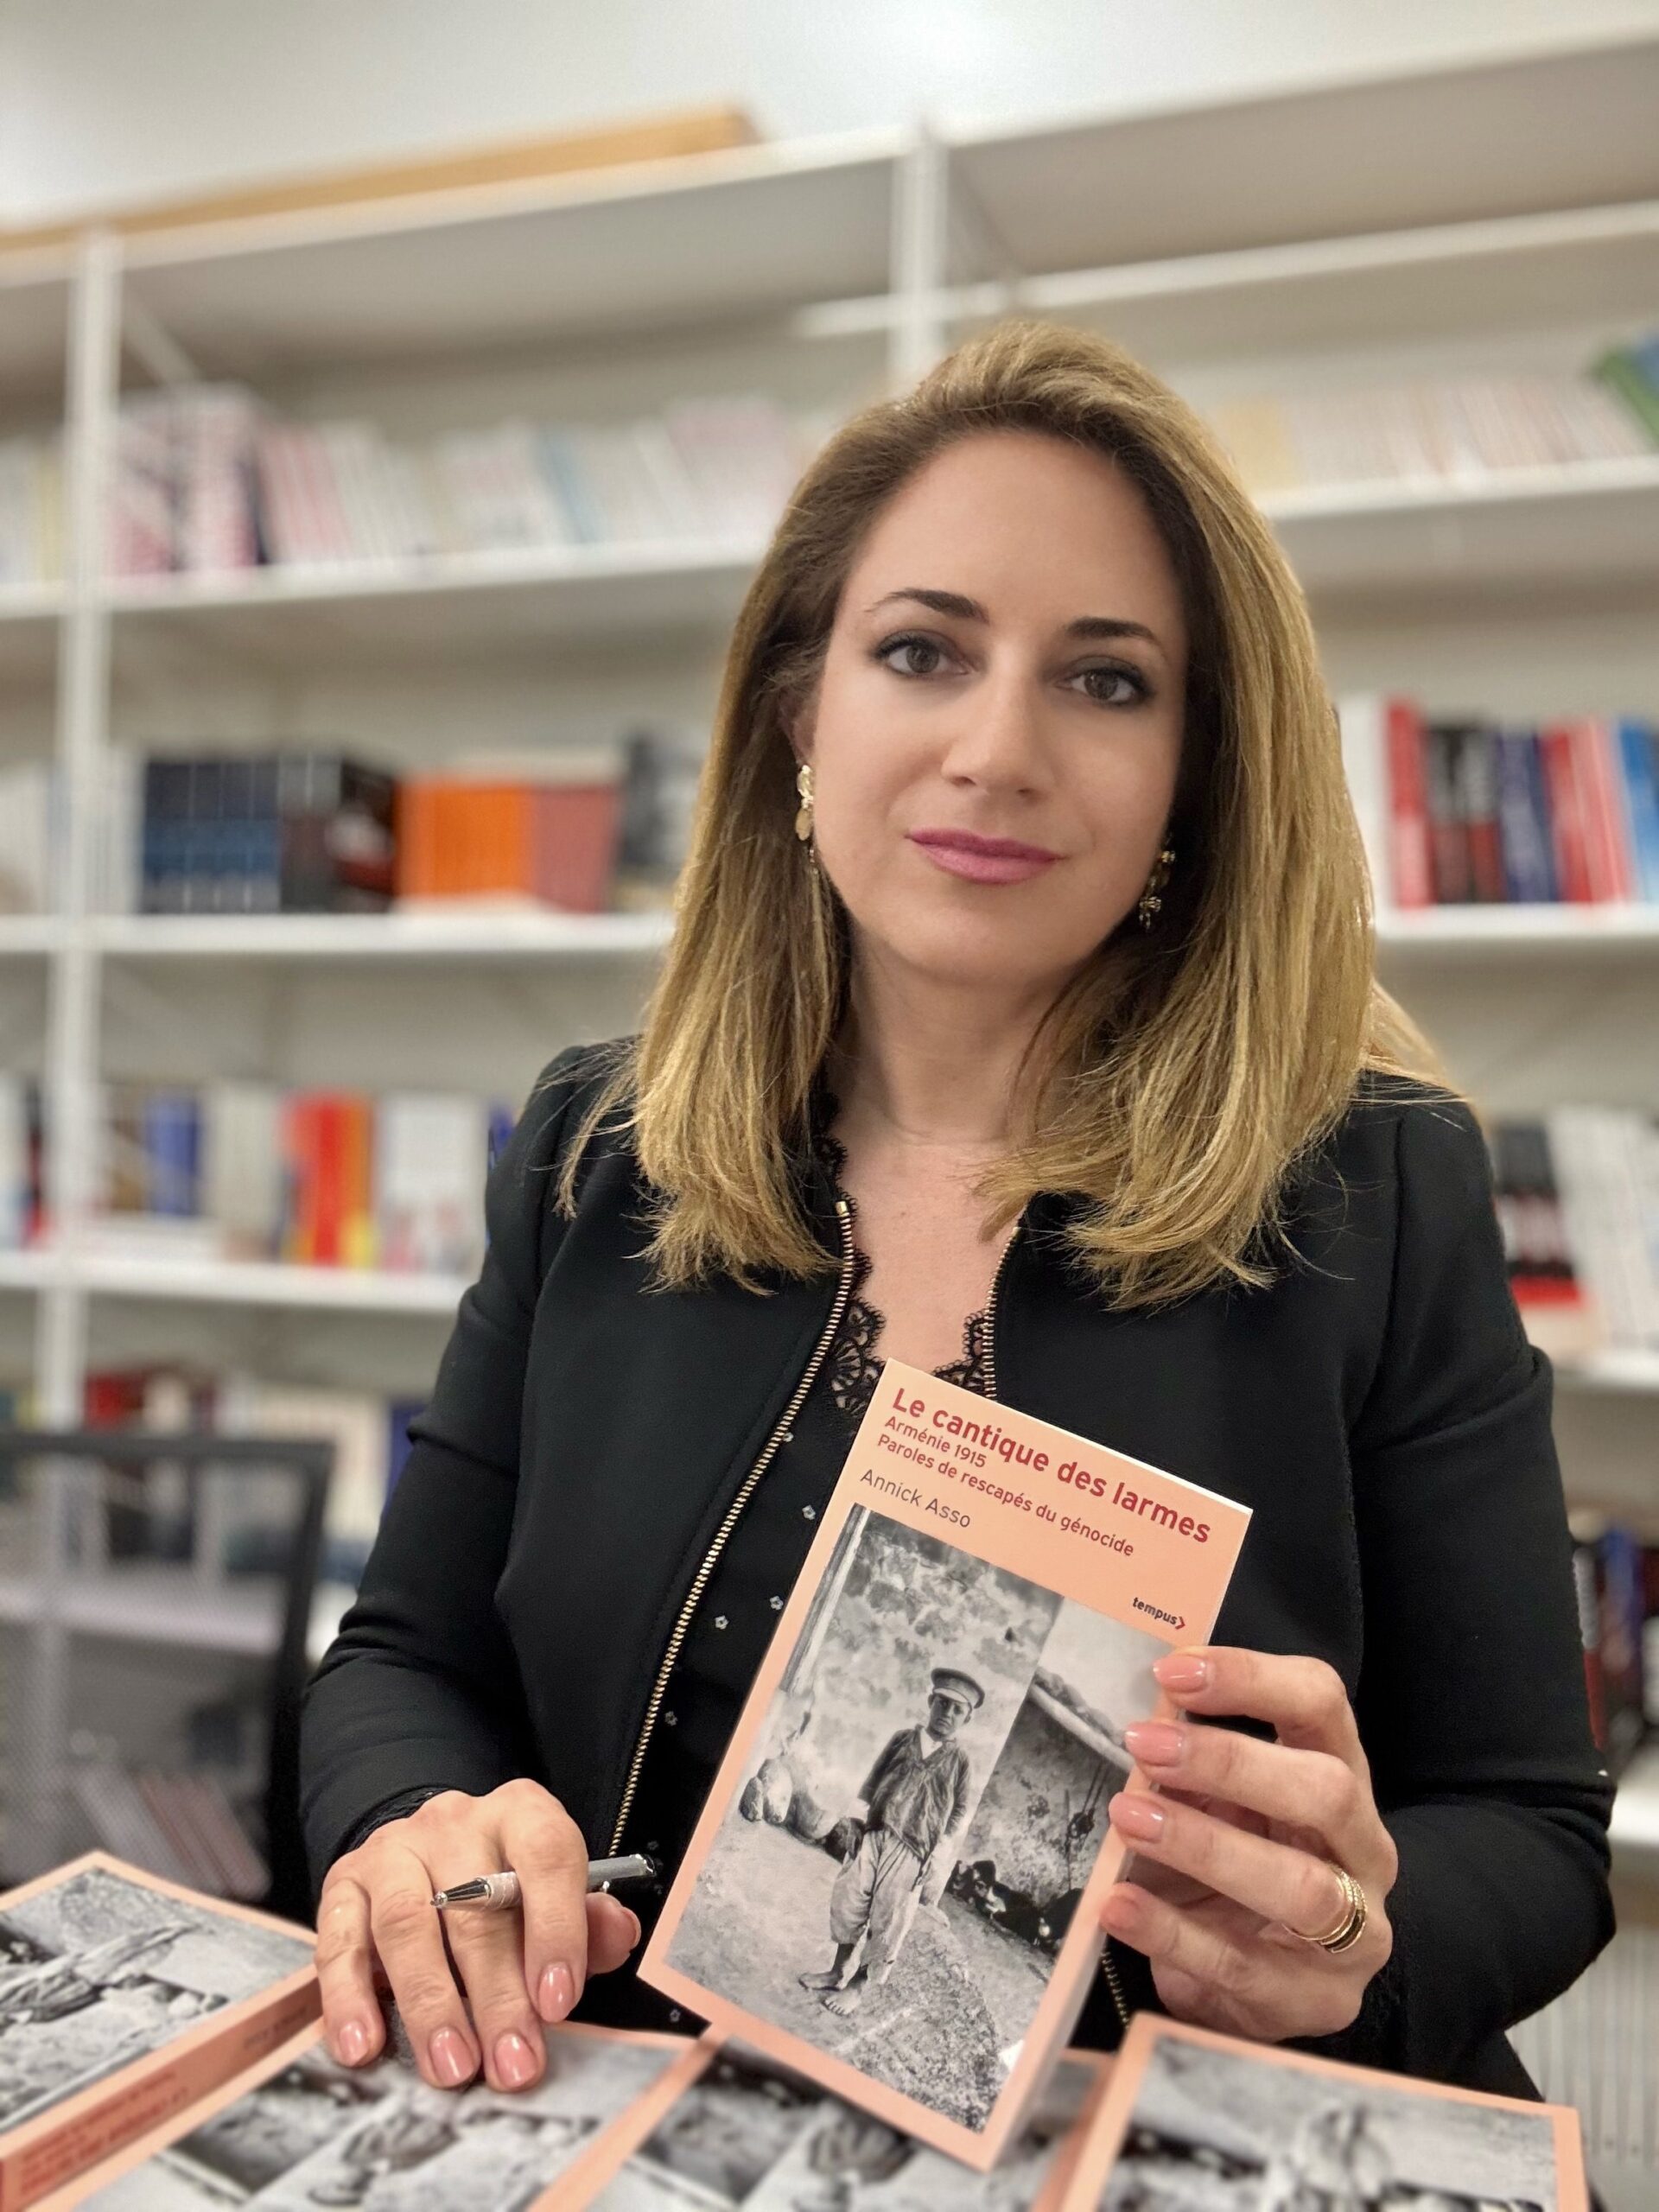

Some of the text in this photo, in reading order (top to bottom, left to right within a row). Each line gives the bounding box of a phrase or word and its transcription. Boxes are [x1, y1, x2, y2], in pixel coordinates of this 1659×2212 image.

[884, 1415, 987, 1468] Arménie 1915
[893, 1388, 1211, 1543] Le cantique des larmes
[860, 1468, 971, 1529] Annick Asso
[877, 1433, 1134, 1557] Paroles de rescapés du génocide
[1132, 1597, 1178, 1626] tempus
